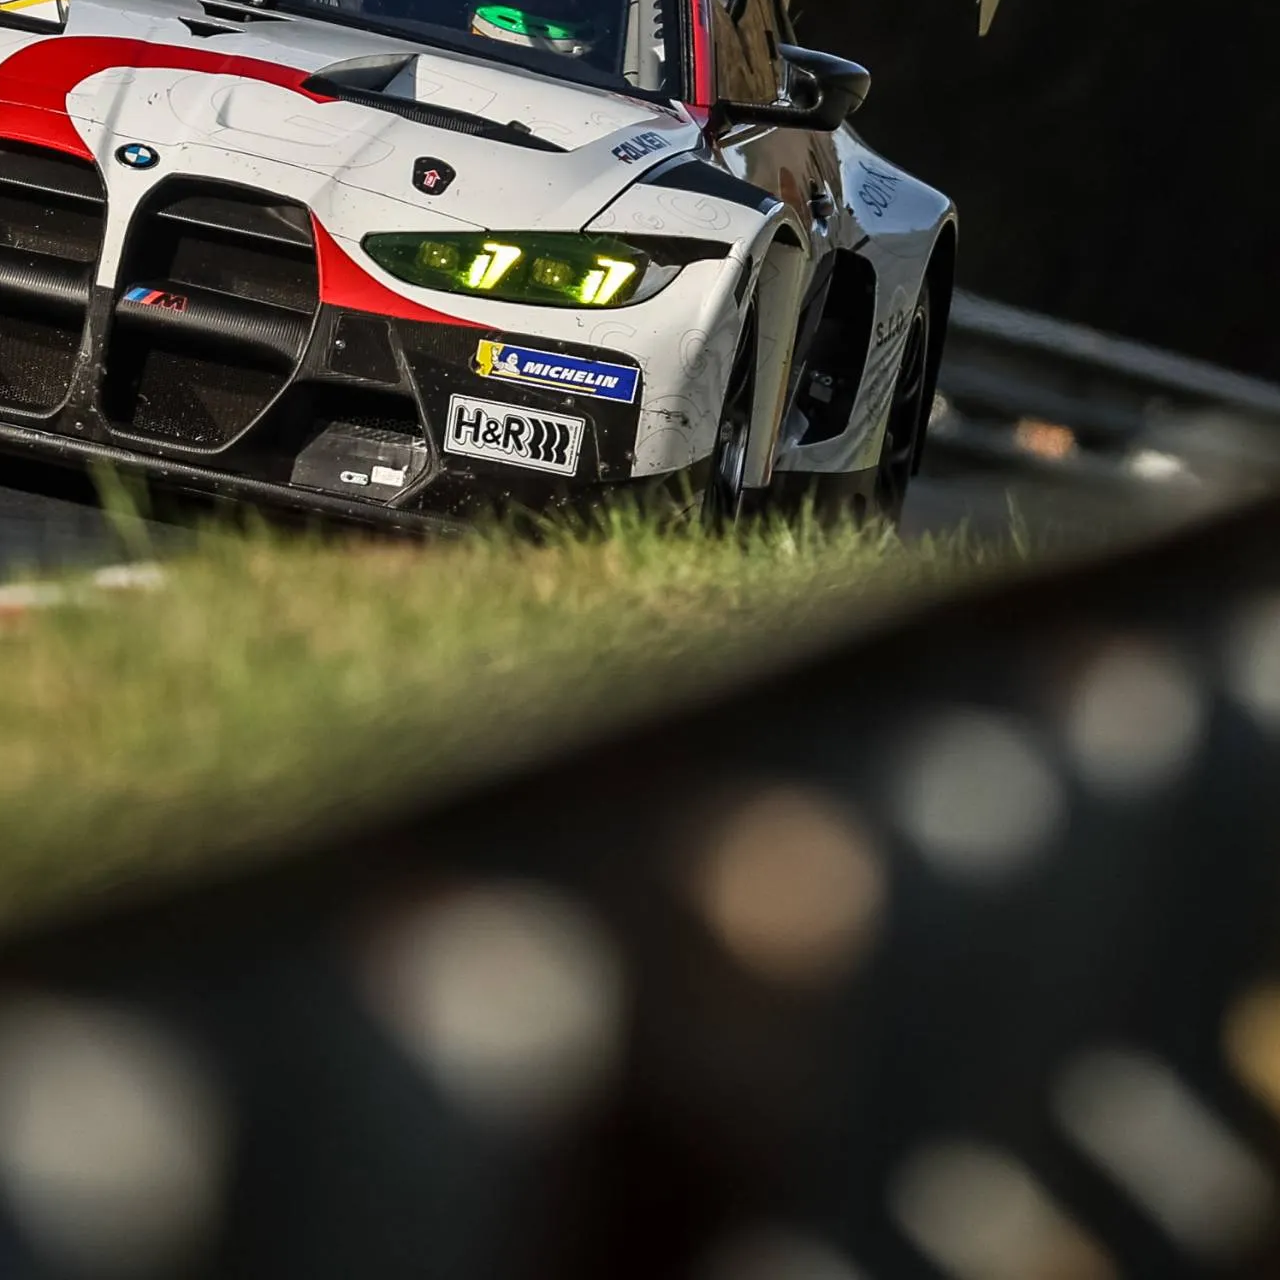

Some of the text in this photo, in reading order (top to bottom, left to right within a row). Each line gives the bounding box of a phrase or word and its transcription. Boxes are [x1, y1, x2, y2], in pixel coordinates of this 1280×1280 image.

[610, 131, 673, 165] FALKEN
[523, 361, 619, 388] MICHELIN
[454, 407, 528, 452] H&R
